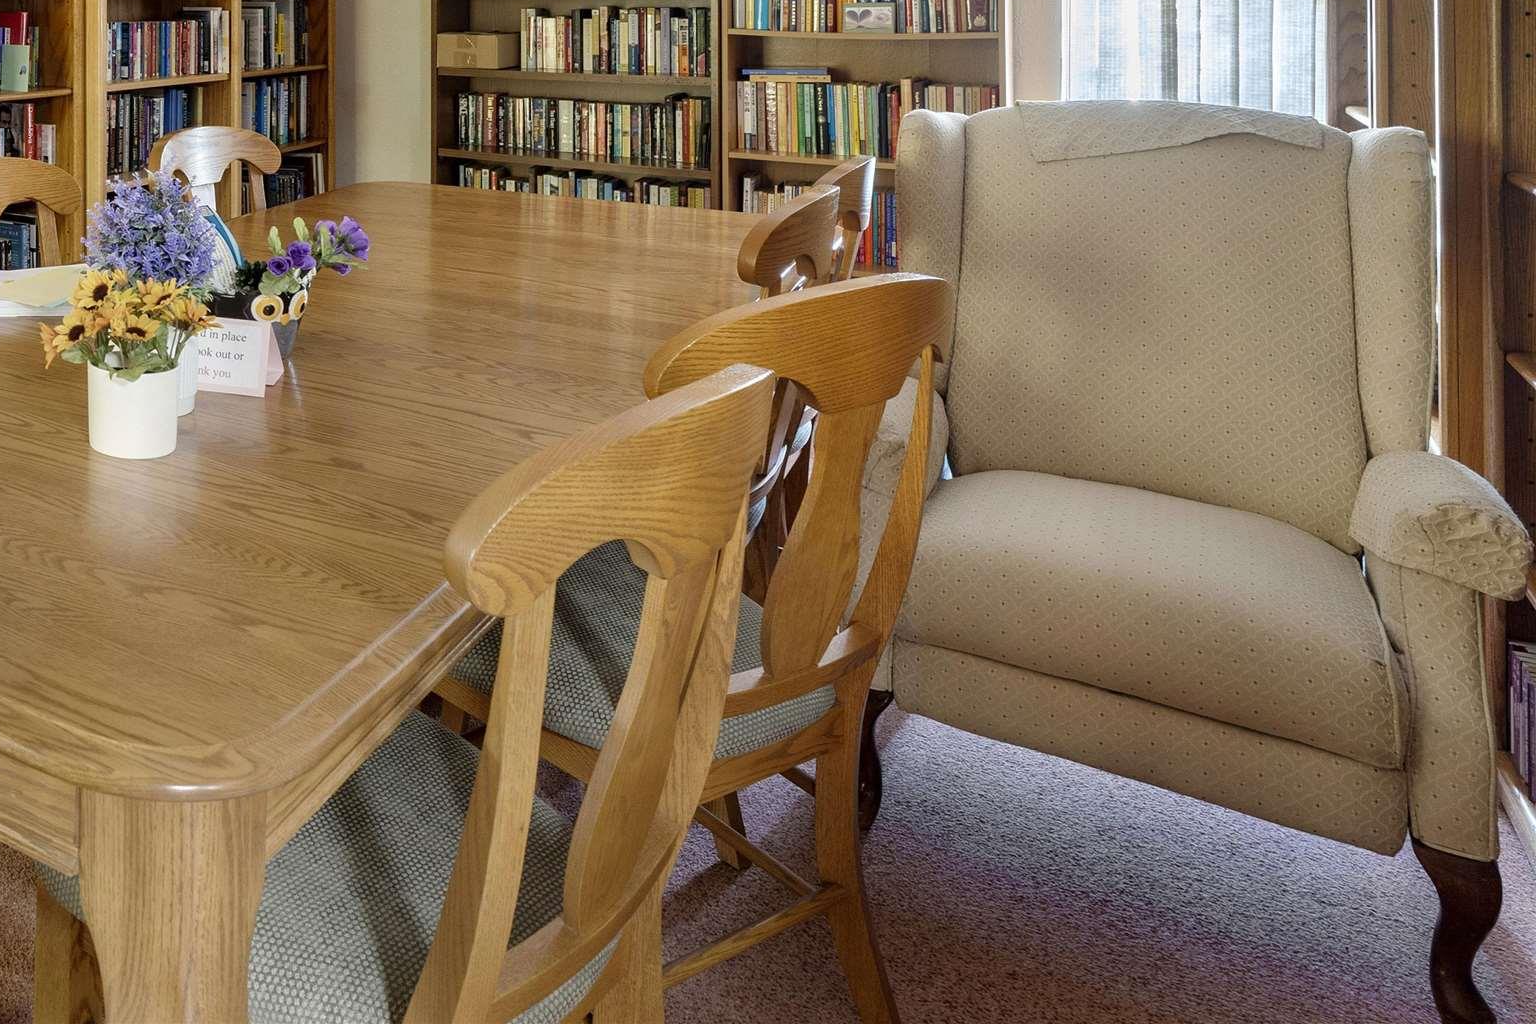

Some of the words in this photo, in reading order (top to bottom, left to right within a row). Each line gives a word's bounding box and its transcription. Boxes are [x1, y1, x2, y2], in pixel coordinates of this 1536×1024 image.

[209, 331, 219, 339] in
[221, 331, 247, 342] place
[215, 351, 232, 360] out
[233, 353, 245, 361] or
[213, 368, 232, 380] you
